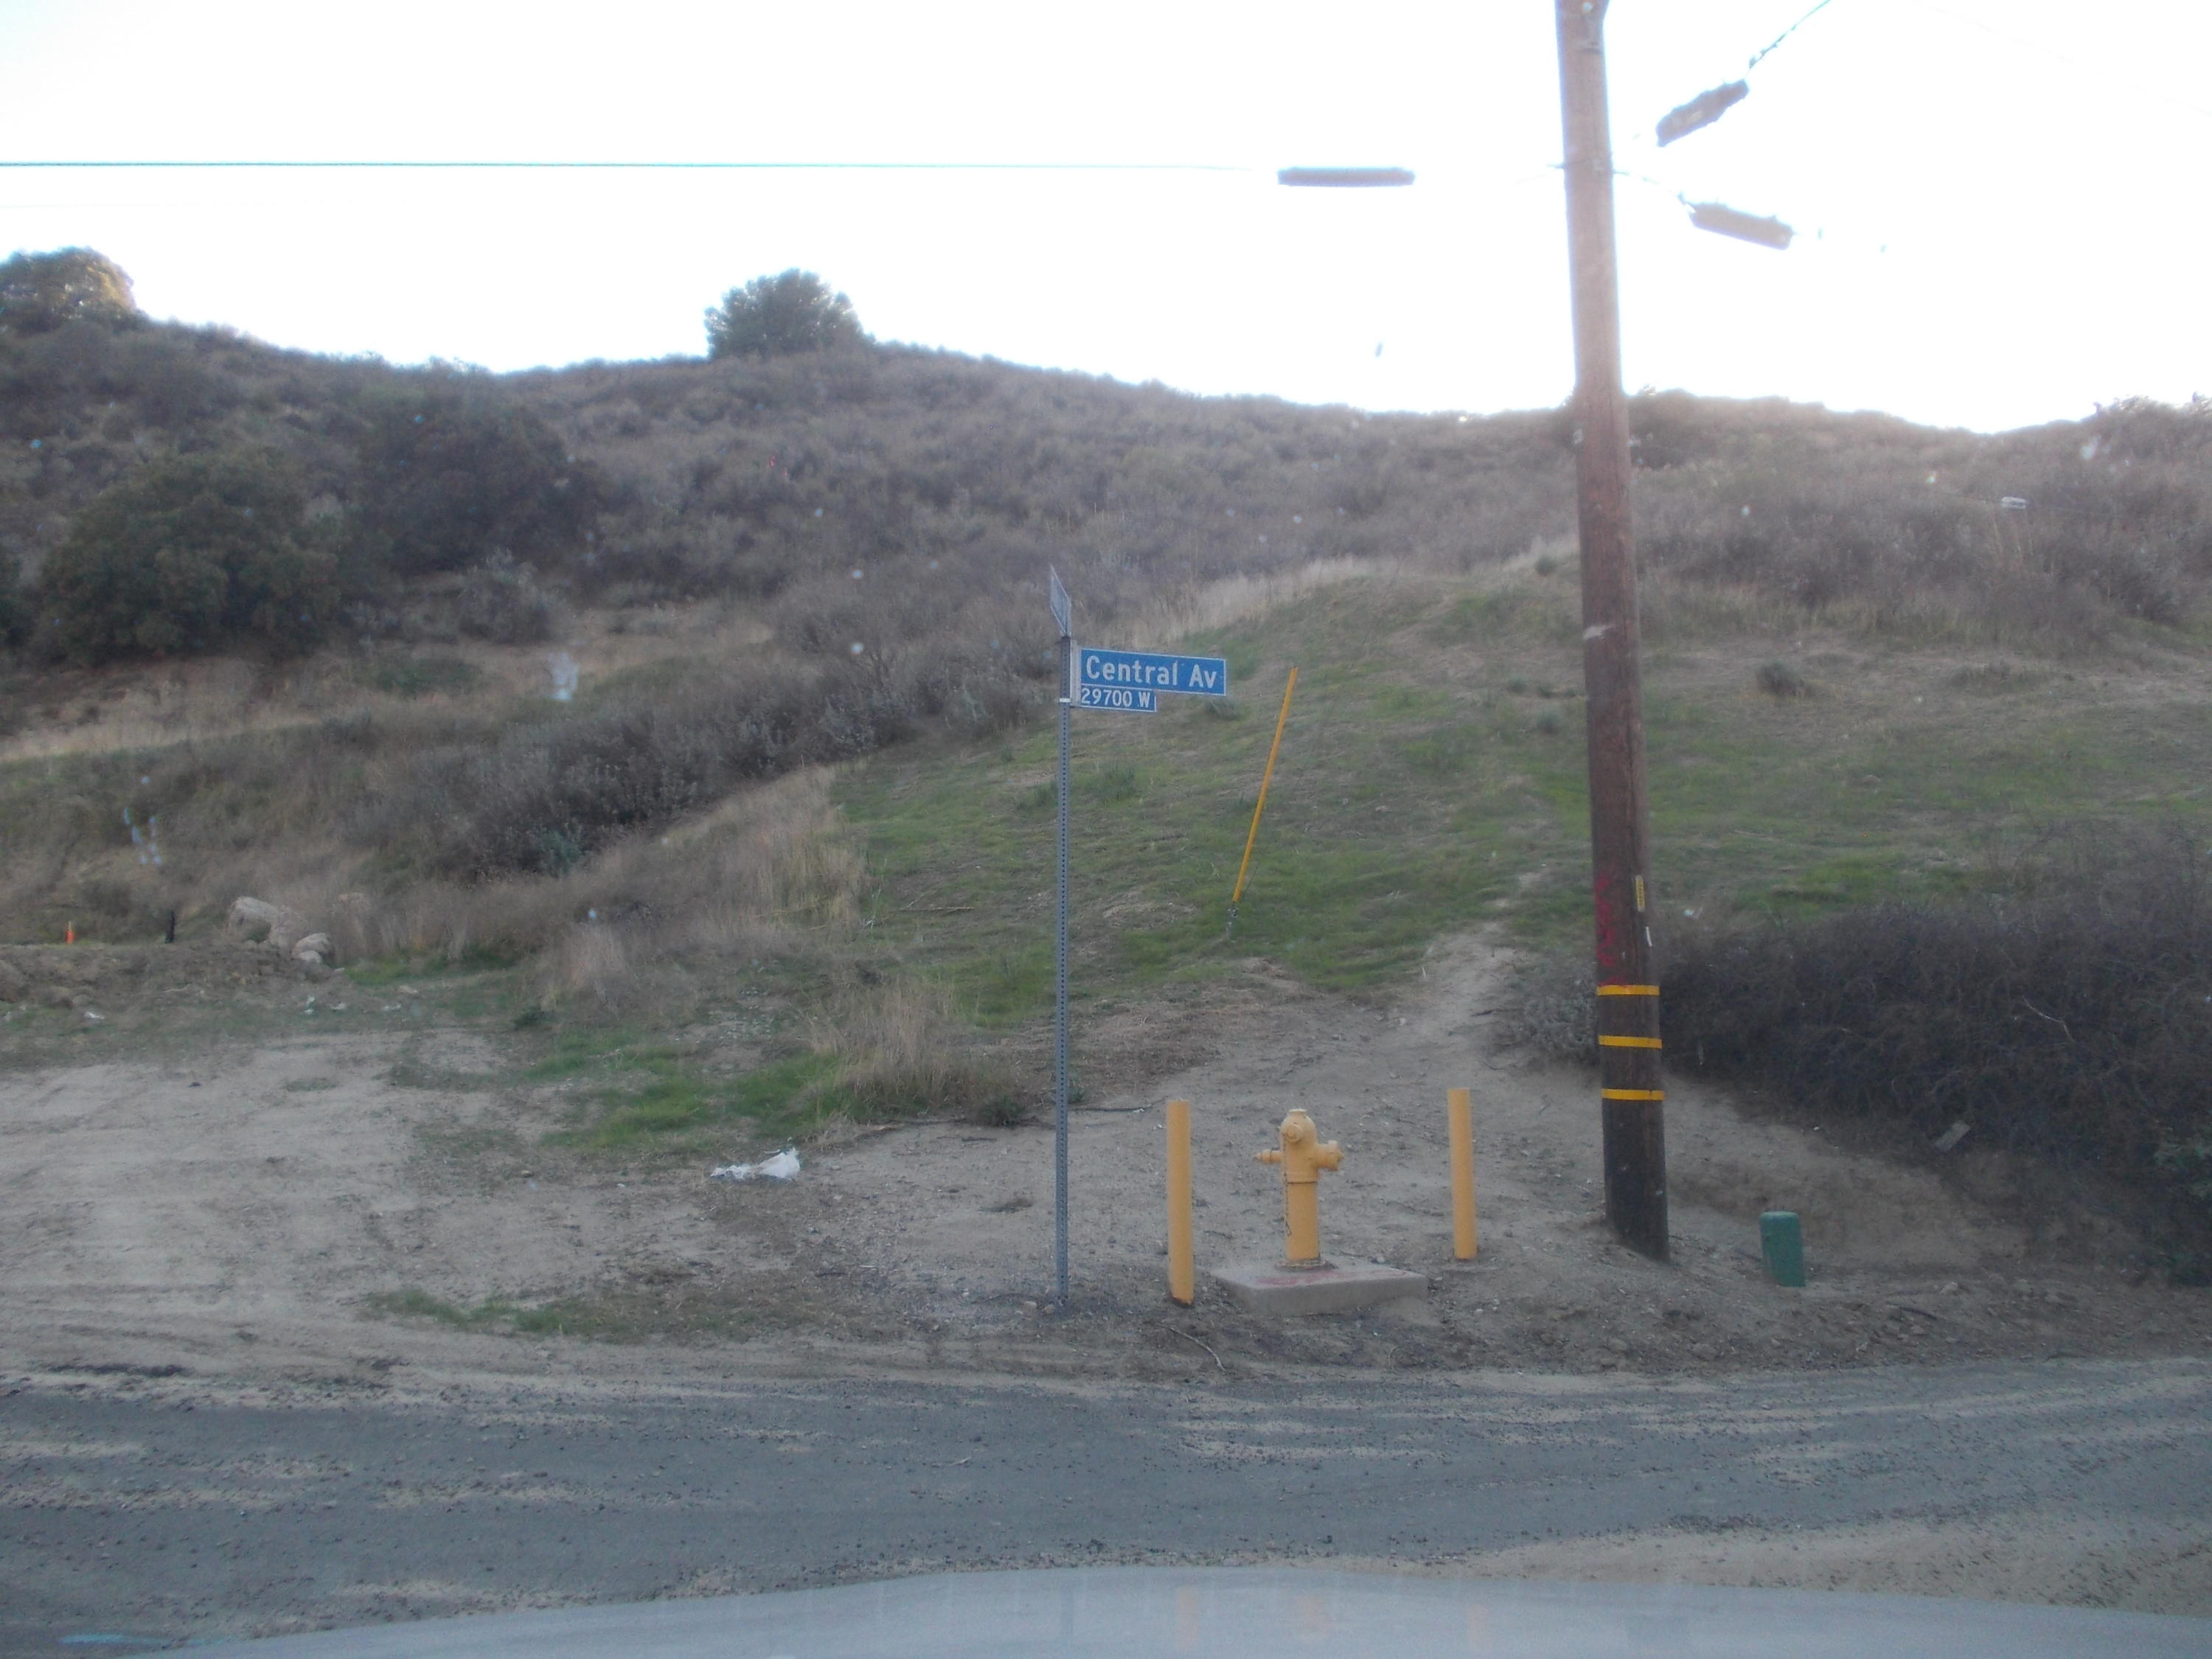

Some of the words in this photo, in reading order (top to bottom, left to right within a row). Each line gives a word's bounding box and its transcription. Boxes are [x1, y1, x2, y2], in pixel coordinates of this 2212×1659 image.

[1086, 655, 1178, 686] Central
[1189, 664, 1217, 688] Av
[1081, 687, 1133, 706] 29700
[1138, 692, 1150, 708] W
